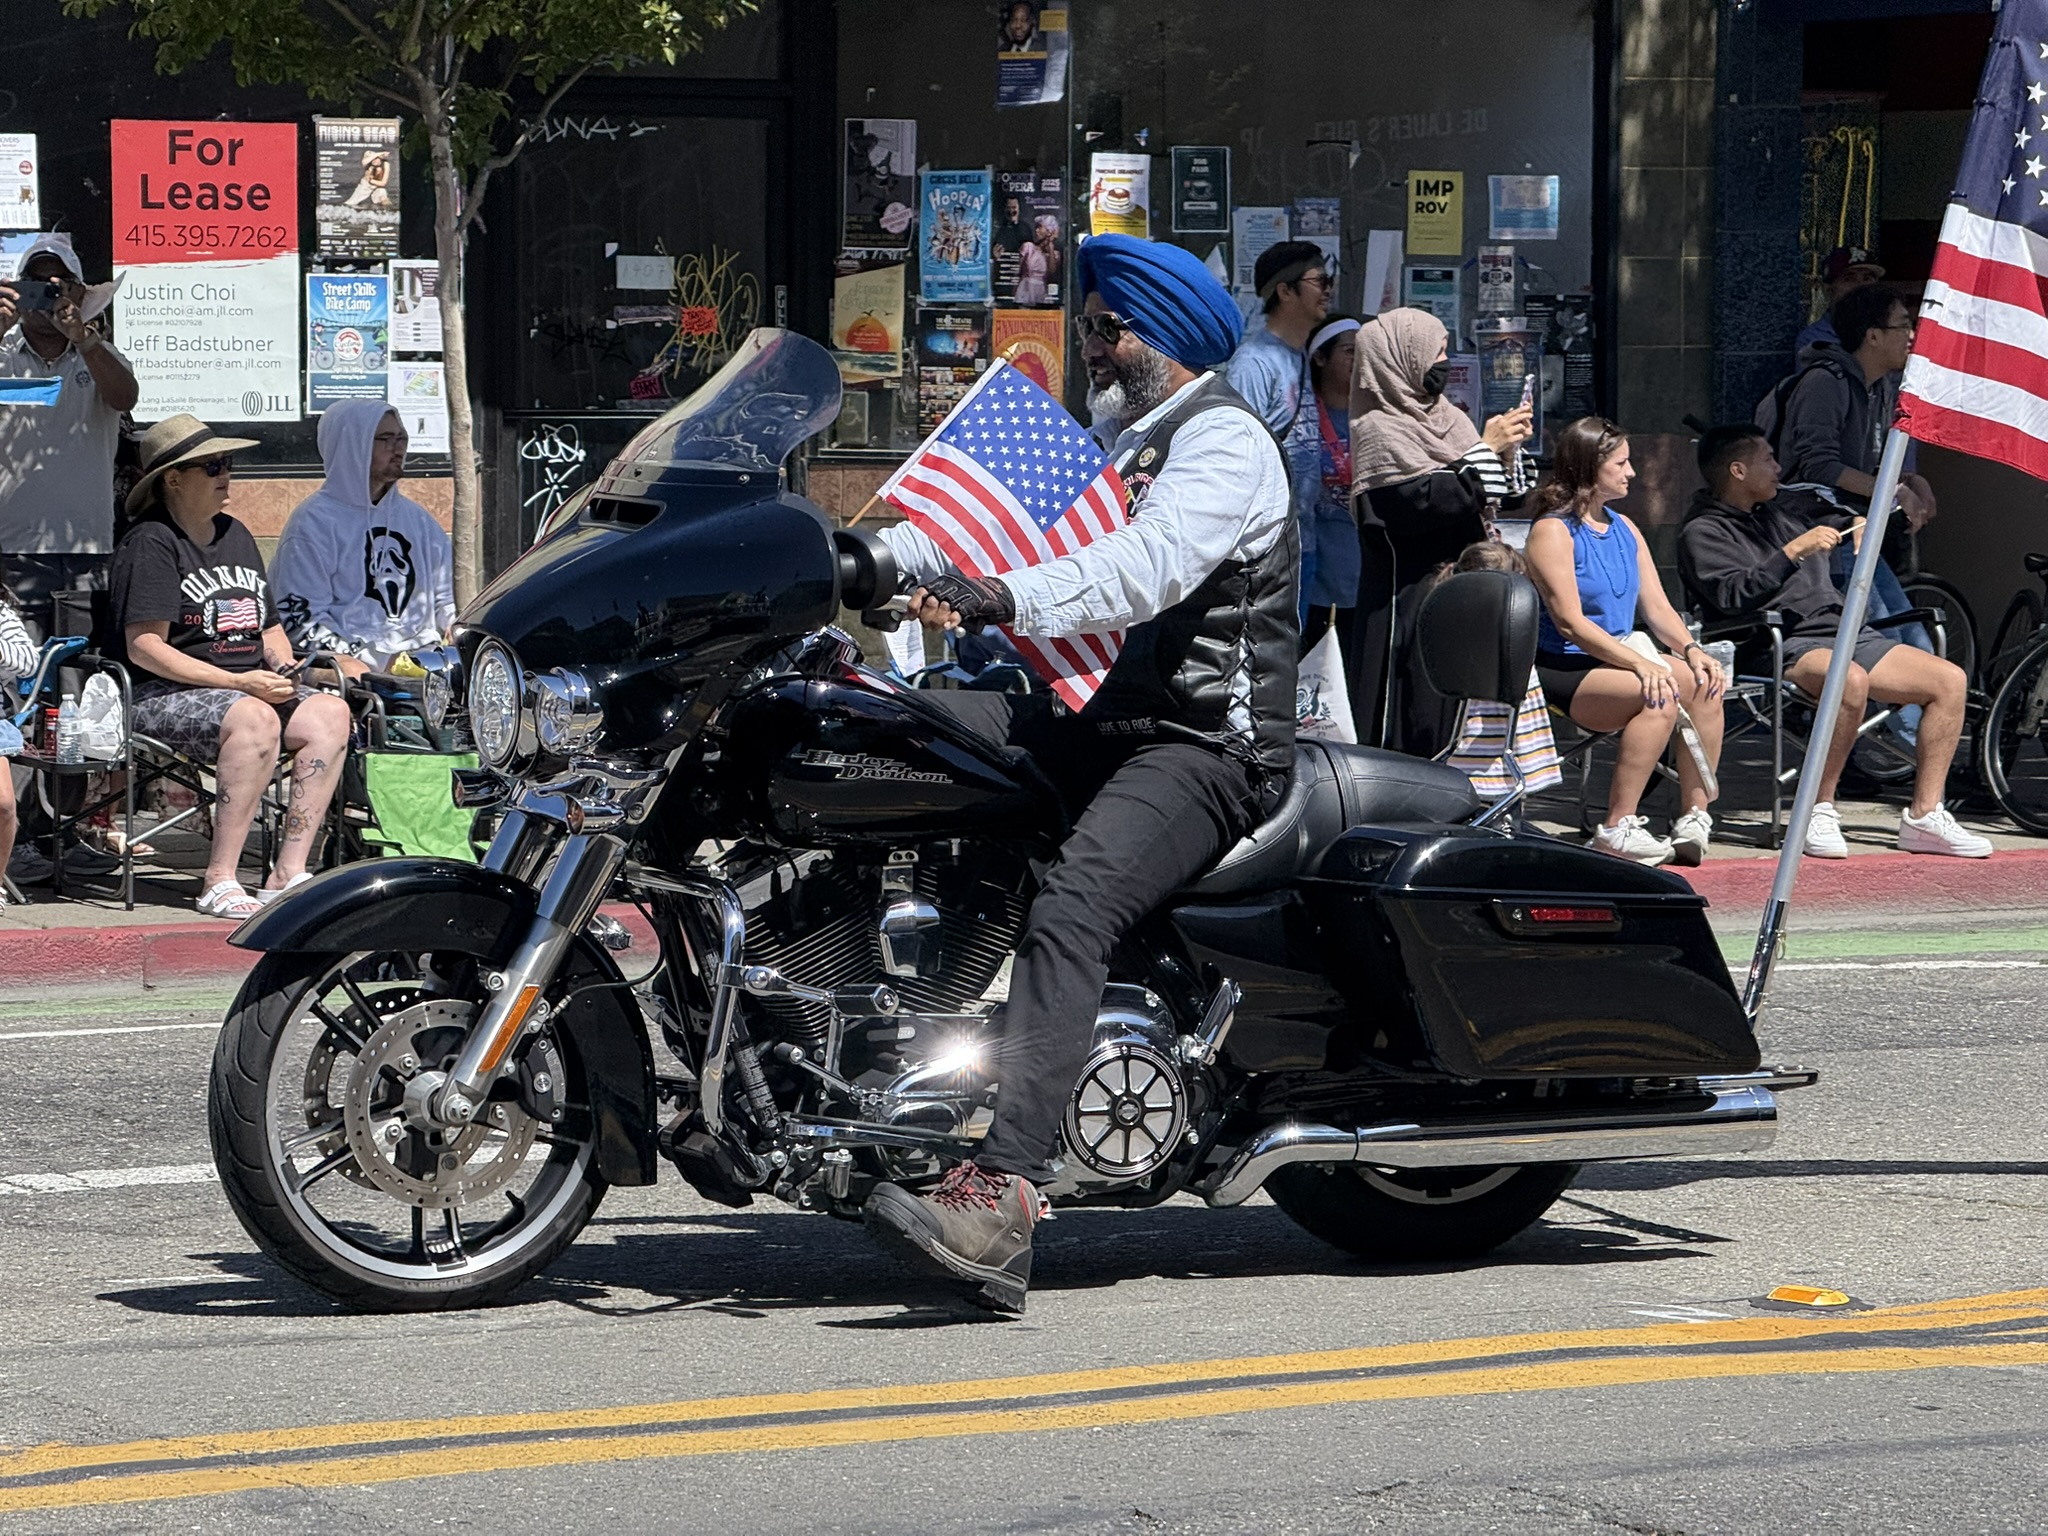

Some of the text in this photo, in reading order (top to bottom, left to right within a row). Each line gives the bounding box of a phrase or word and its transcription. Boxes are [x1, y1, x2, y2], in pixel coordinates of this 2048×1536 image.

[362, 126, 397, 138] SEAS
[168, 129, 244, 166] For
[140, 174, 271, 211] Lease
[1415, 179, 1454, 197] IMP
[1414, 201, 1448, 214] ROV
[125, 224, 287, 248] 415.395.7262
[123, 283, 236, 301] Justin Choi
[322, 281, 377, 296] Street Skills
[125, 305, 254, 318] justin.choi@am.jll.com
[325, 296, 371, 313] Bike Camp
[123, 335, 275, 352] Jeff Badstubner
[130, 358, 282, 370] eff.badstubner@am.jll.com
[141, 396, 160, 404] Lang
[264, 395, 295, 412] JLL
[180, 565, 268, 604] OLD NAVY
[1116, 720, 1131, 731] TO
[796, 749, 900, 769] Harley
[835, 764, 954, 784] Davidson
